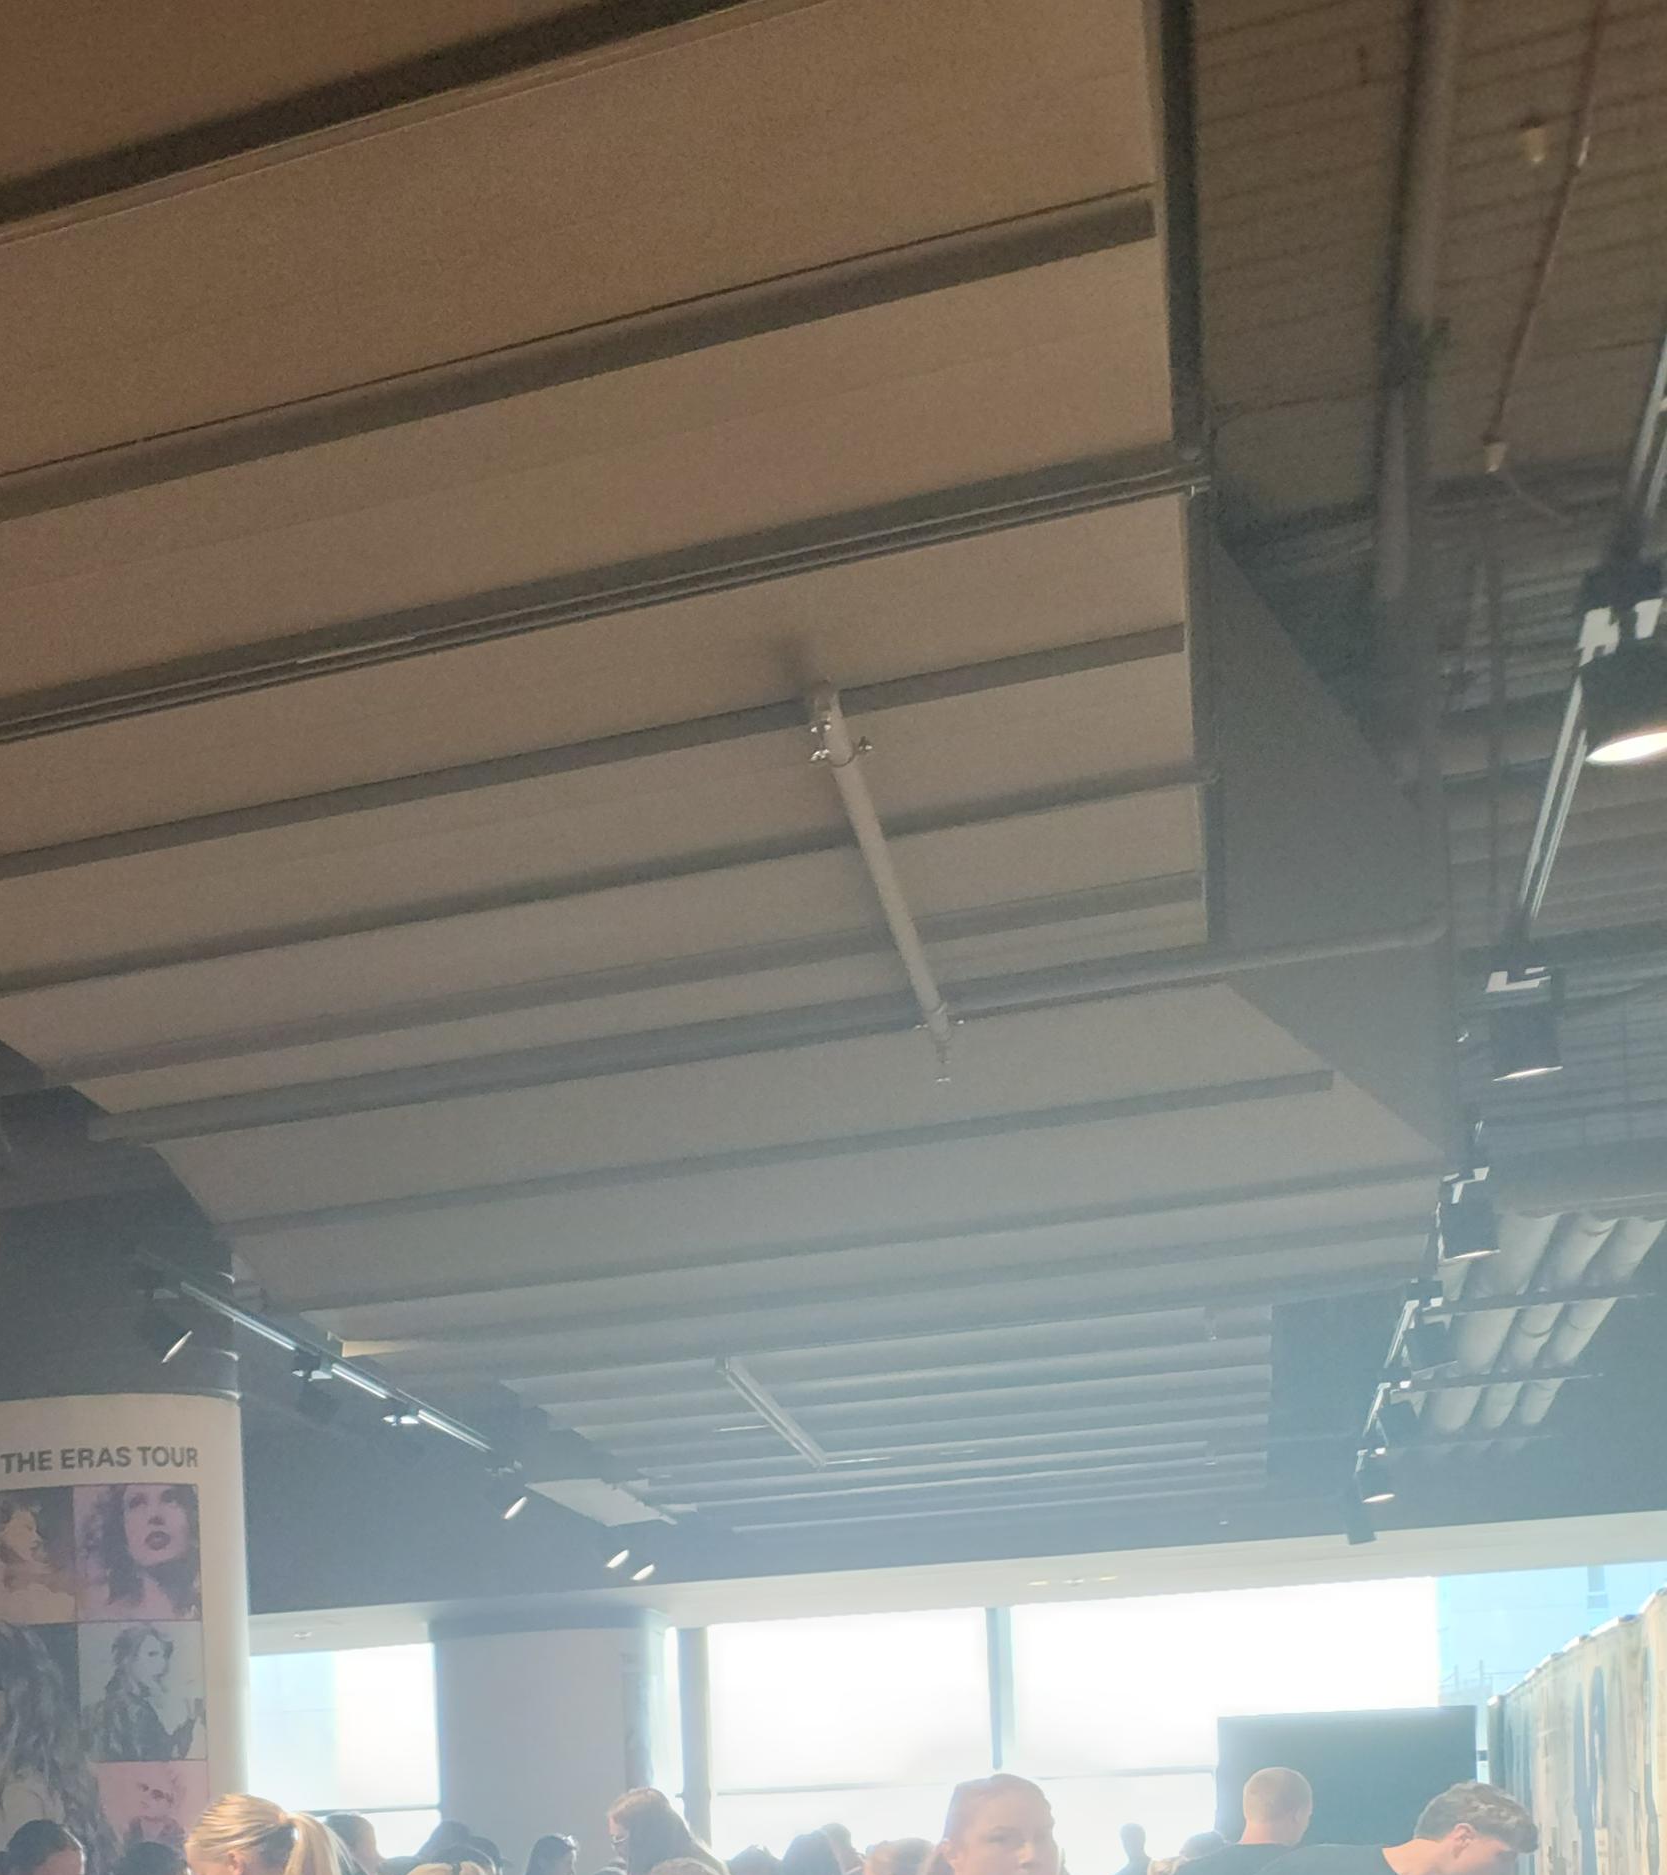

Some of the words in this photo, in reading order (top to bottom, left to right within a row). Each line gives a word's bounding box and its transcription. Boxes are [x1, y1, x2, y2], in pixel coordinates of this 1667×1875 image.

[0, 1449, 53, 1474] THE
[61, 1446, 132, 1470] ERAS
[136, 1445, 198, 1468] TOUR
